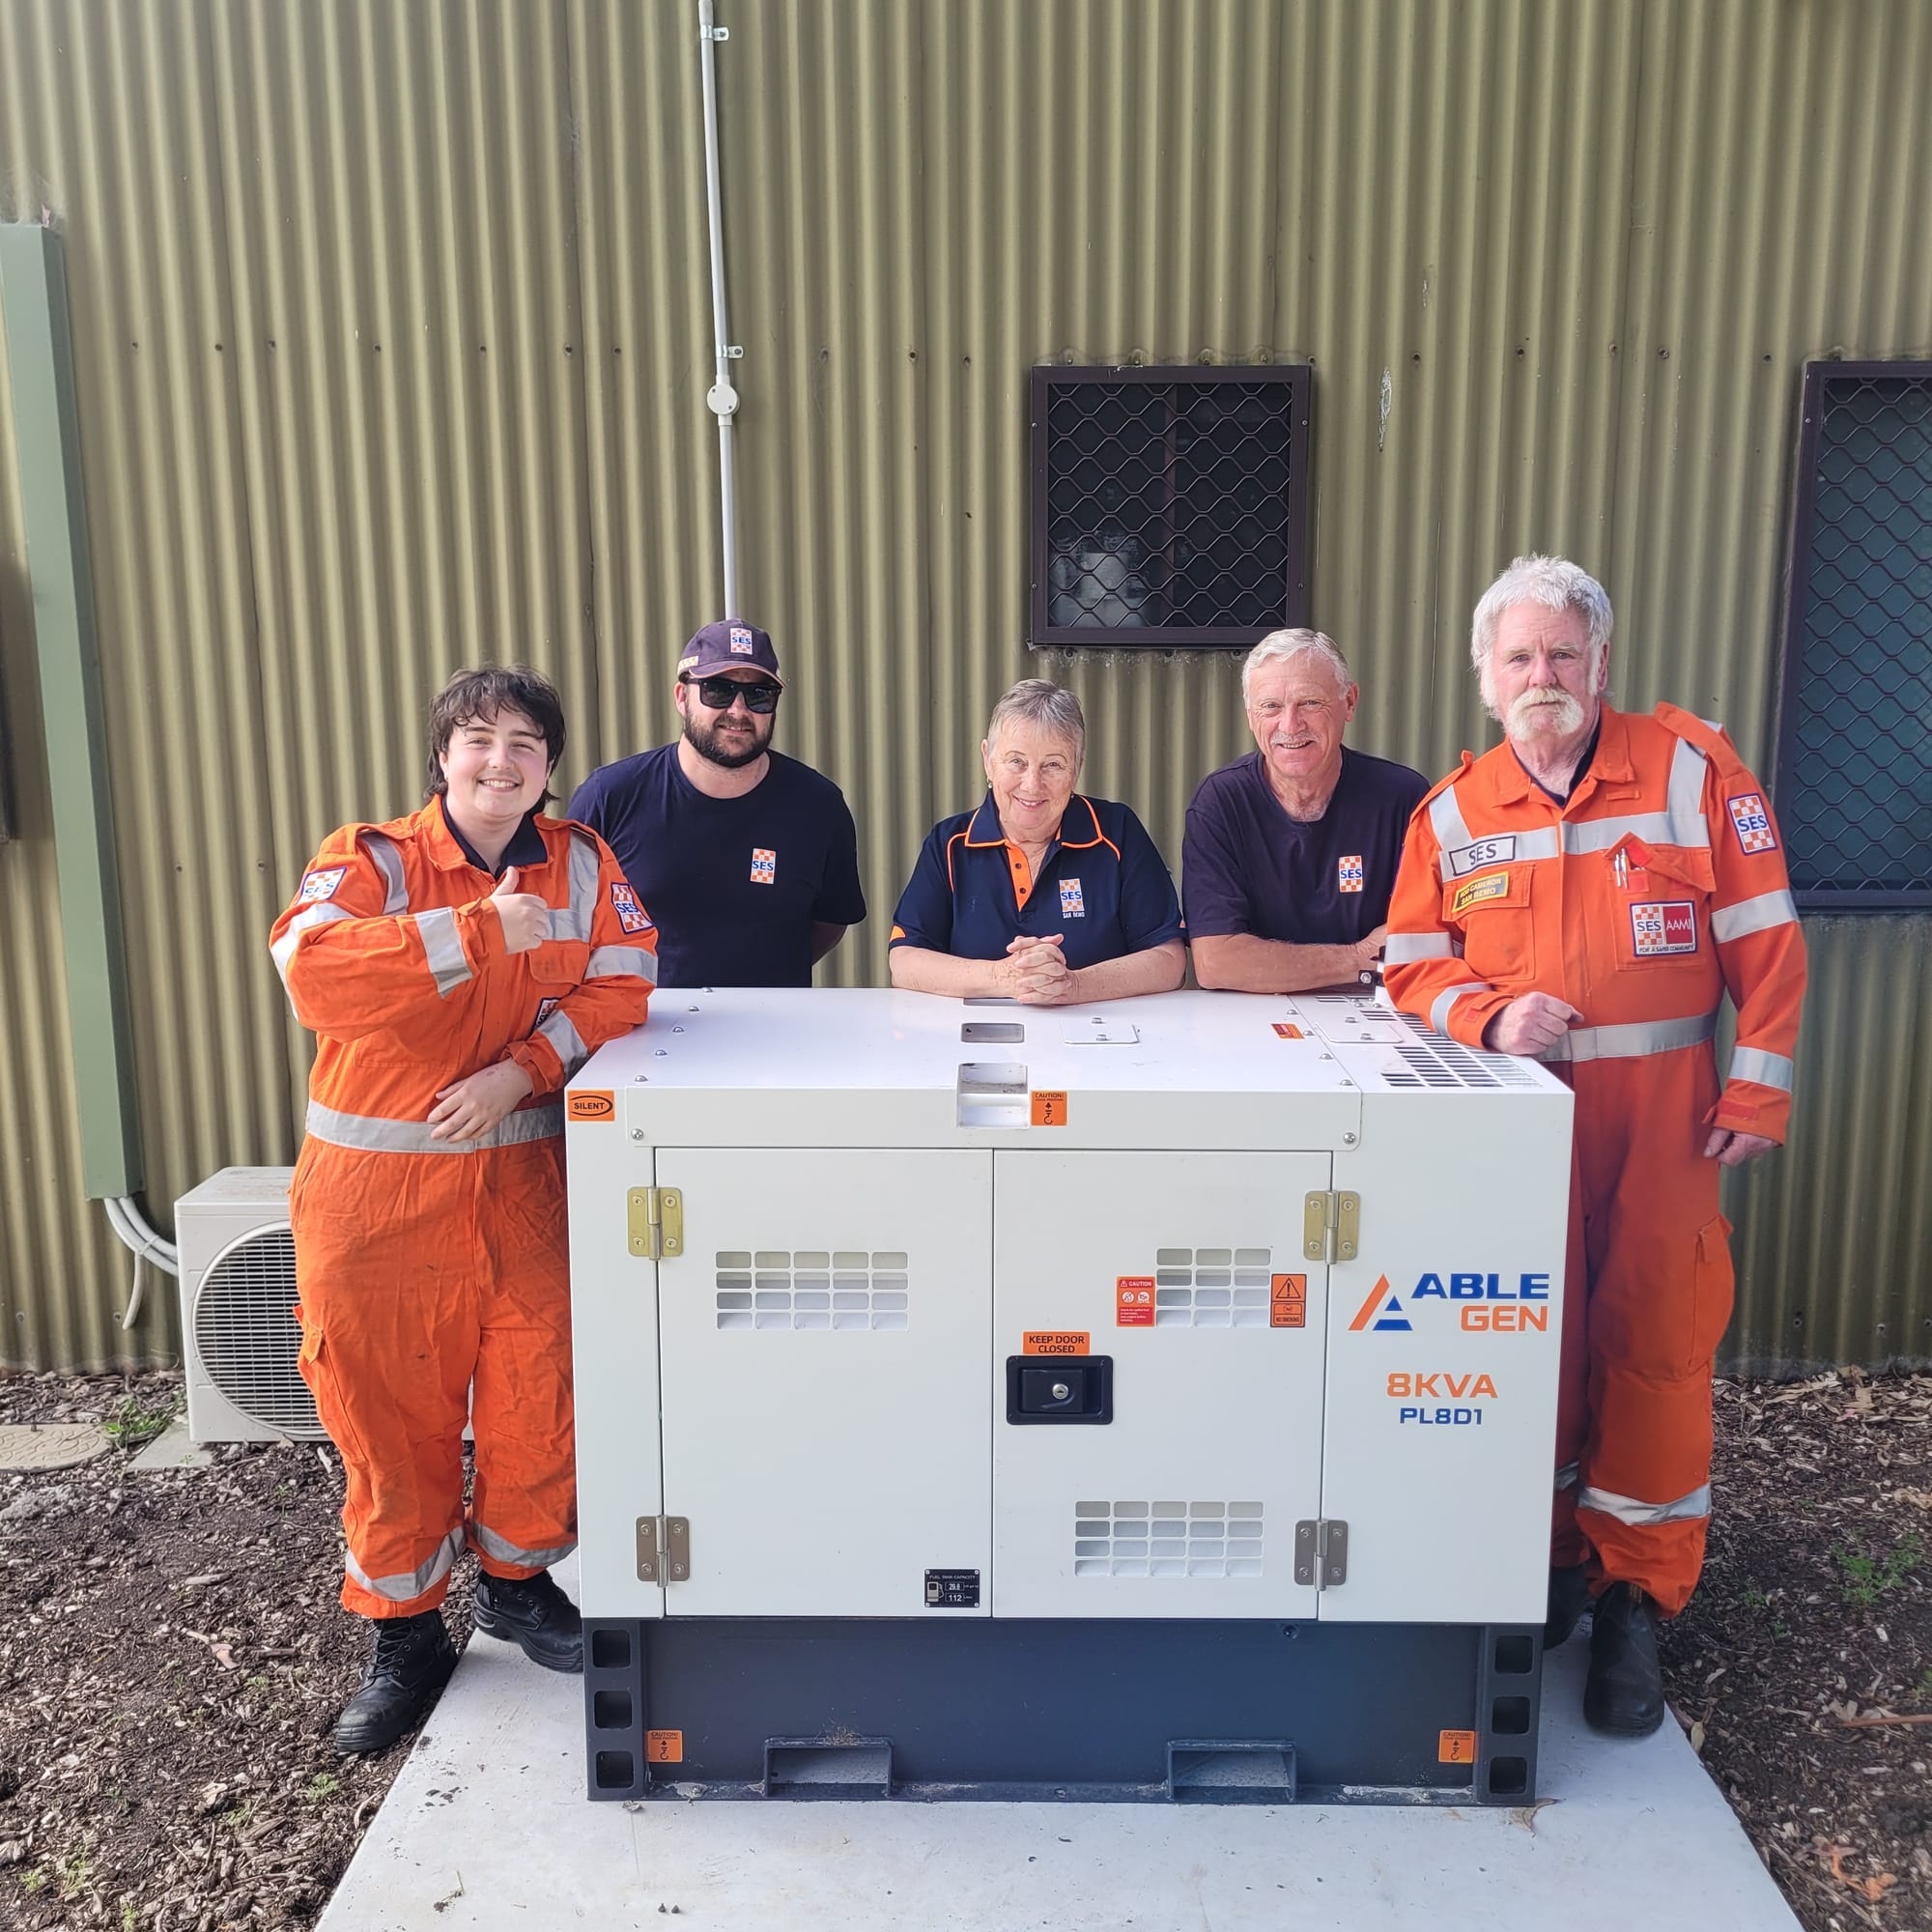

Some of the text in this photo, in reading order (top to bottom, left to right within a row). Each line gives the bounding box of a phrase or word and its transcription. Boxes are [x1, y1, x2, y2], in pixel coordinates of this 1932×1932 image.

[1737, 815, 1767, 832] SES
[1468, 843, 1496, 866] SES
[753, 861, 774, 871] SES
[1340, 869, 1362, 879] SES
[1469, 878, 1502, 892] CAMERON
[1061, 891, 1082, 900] SES
[1461, 888, 1496, 905] SAN REMO
[615, 902, 639, 913] SES
[1637, 918, 1692, 932] SES AAMI
[1410, 1273, 1549, 1299] ABLE
[1461, 1305, 1548, 1332] GEN
[1387, 1373, 1498, 1398] 8KVA
[1400, 1407, 1482, 1425] PL8D1
